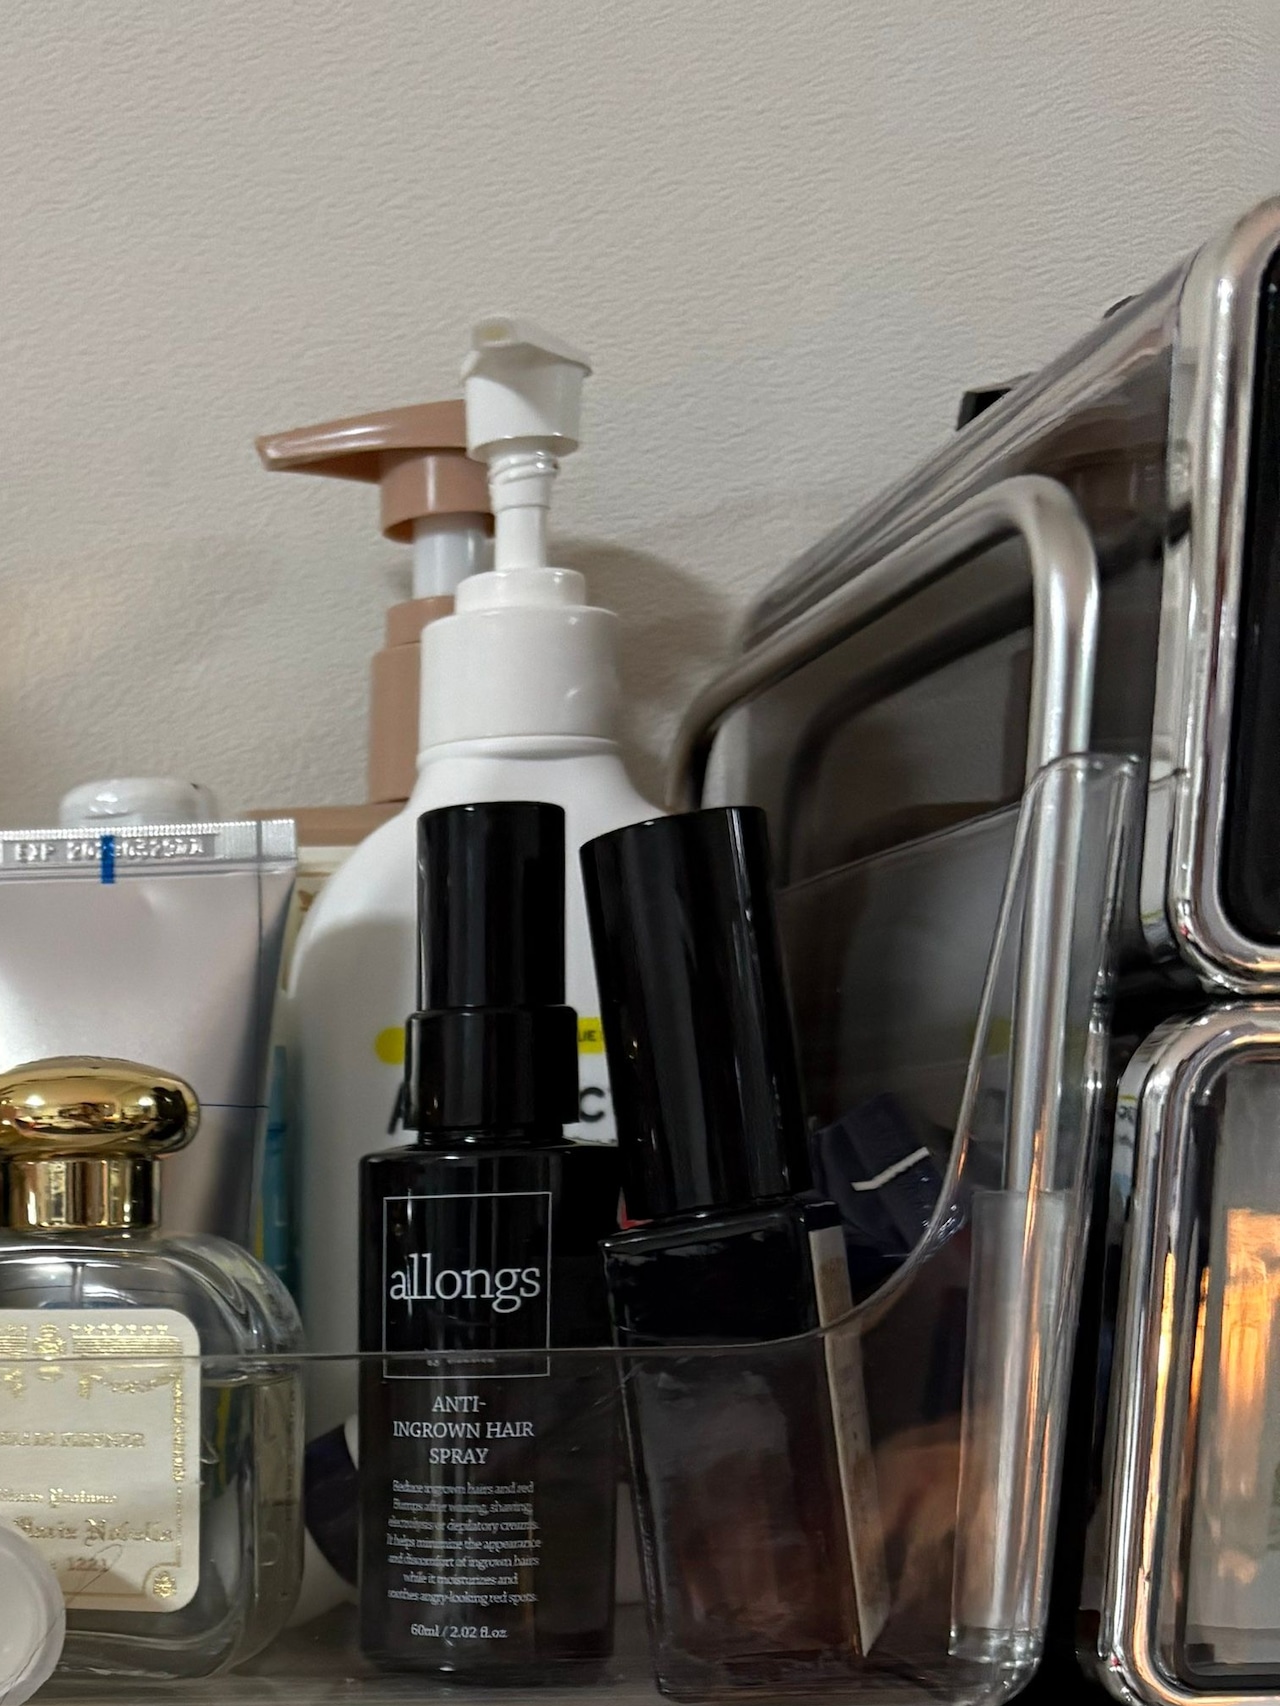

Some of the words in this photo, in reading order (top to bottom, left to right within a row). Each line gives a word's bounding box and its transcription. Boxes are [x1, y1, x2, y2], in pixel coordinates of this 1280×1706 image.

[389, 1252, 541, 1314] allongs
[431, 1395, 487, 1413] ANTI-
[392, 1420, 481, 1439] INGROWN
[486, 1421, 535, 1438] HAIR
[428, 1447, 489, 1465] SPRAY
[410, 1622, 440, 1638] 60ml
[450, 1625, 477, 1639] 2.02
